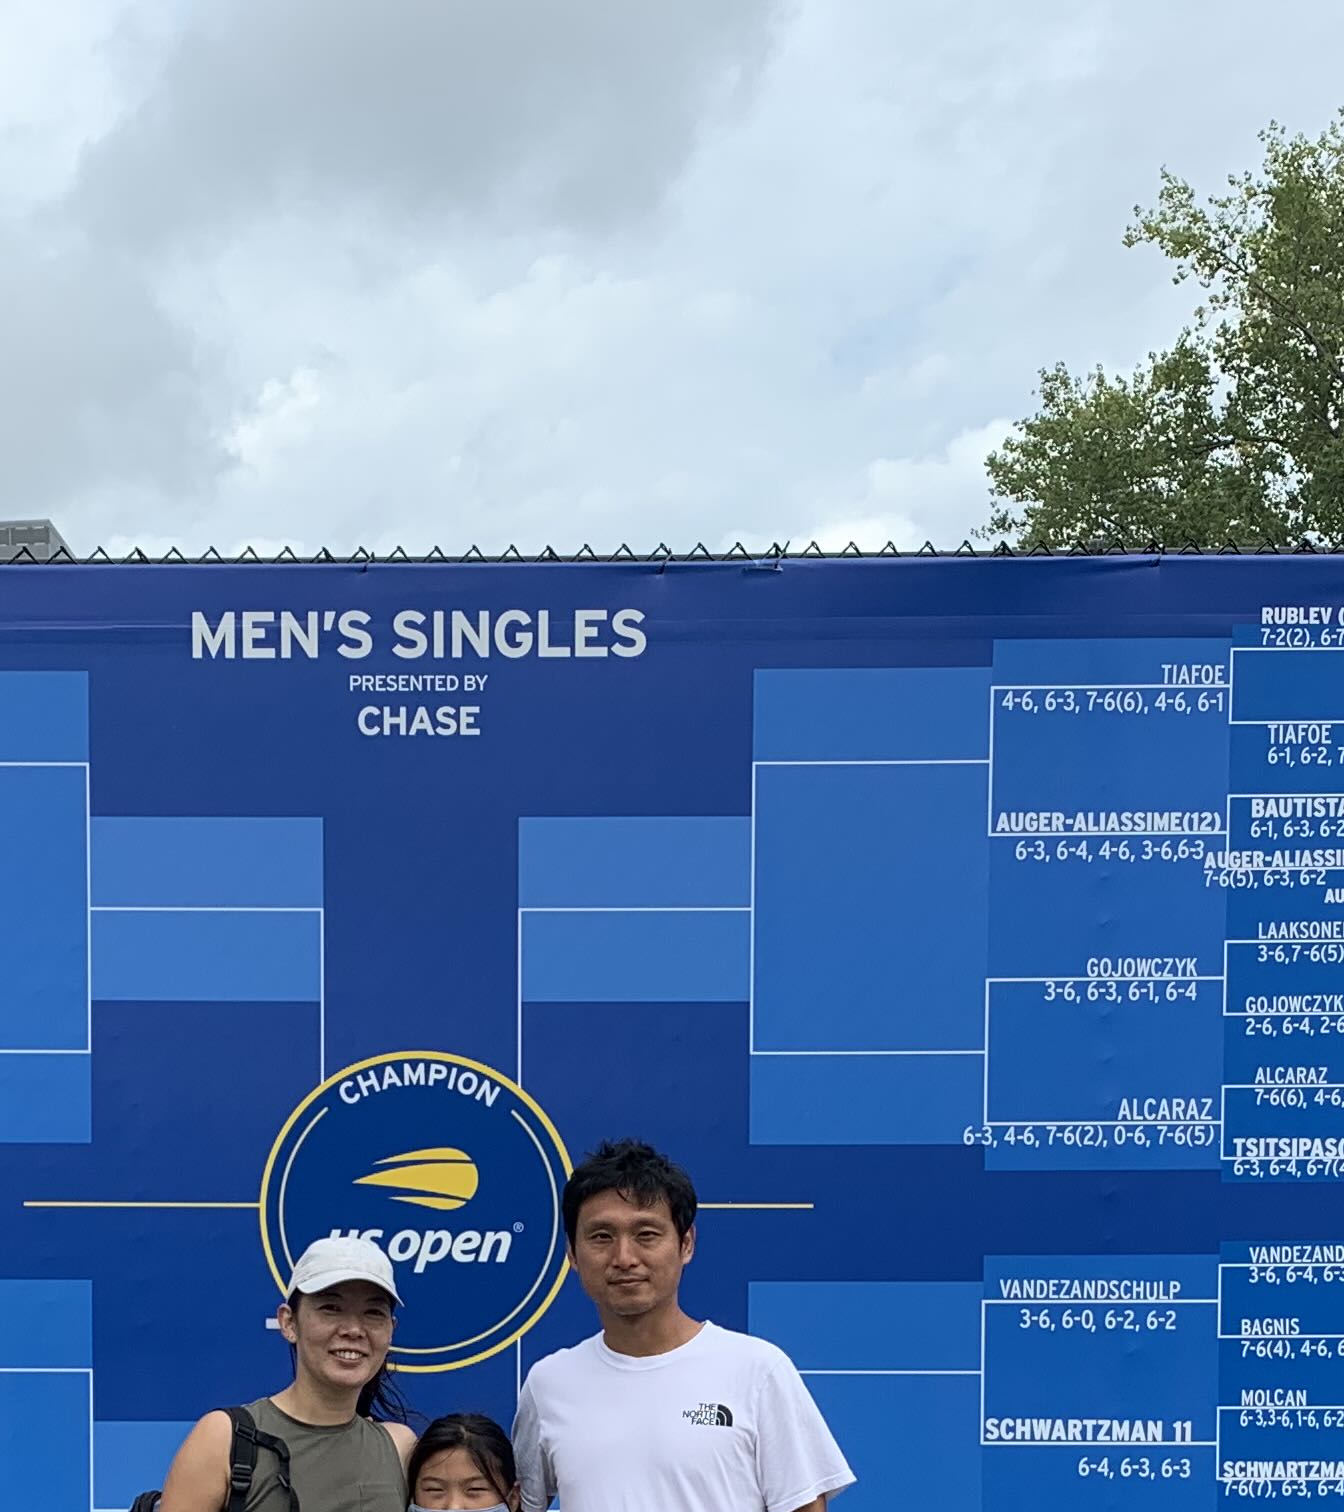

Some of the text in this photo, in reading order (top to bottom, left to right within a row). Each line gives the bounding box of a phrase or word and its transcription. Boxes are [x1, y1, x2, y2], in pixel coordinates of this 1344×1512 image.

[1261, 606, 1333, 625] RUBLEV
[192, 609, 646, 658] MEN'S SINGLES
[350, 675, 488, 691] PRESENTED BY
[1161, 664, 1225, 685] TIAFOE
[1197, 691, 1224, 712] 6-1
[358, 706, 480, 735] CHASE
[1267, 724, 1332, 745] TIAFOE
[995, 811, 1224, 833] AUGER-ALIASSIME(12)
[1086, 957, 1199, 978] GOJOWCZYK
[339, 1062, 501, 1107] CHAMPION
[1254, 1066, 1328, 1085] ALCARAZ
[1117, 1097, 1213, 1121] ALCARAZ
[999, 1279, 1183, 1301] VANDEZANDSCHULP
[1146, 1309, 1177, 1330] 6-2
[1241, 1317, 1300, 1335] BAGNIS
[698, 1402, 717, 1411] THE
[1241, 1388, 1307, 1407] MOLCAN
[682, 1409, 716, 1419] NORTH
[691, 1417, 715, 1426] FACE
[985, 1417, 1192, 1442] SCHWARTZMAN 11
[1161, 1458, 1191, 1479] 6-3
